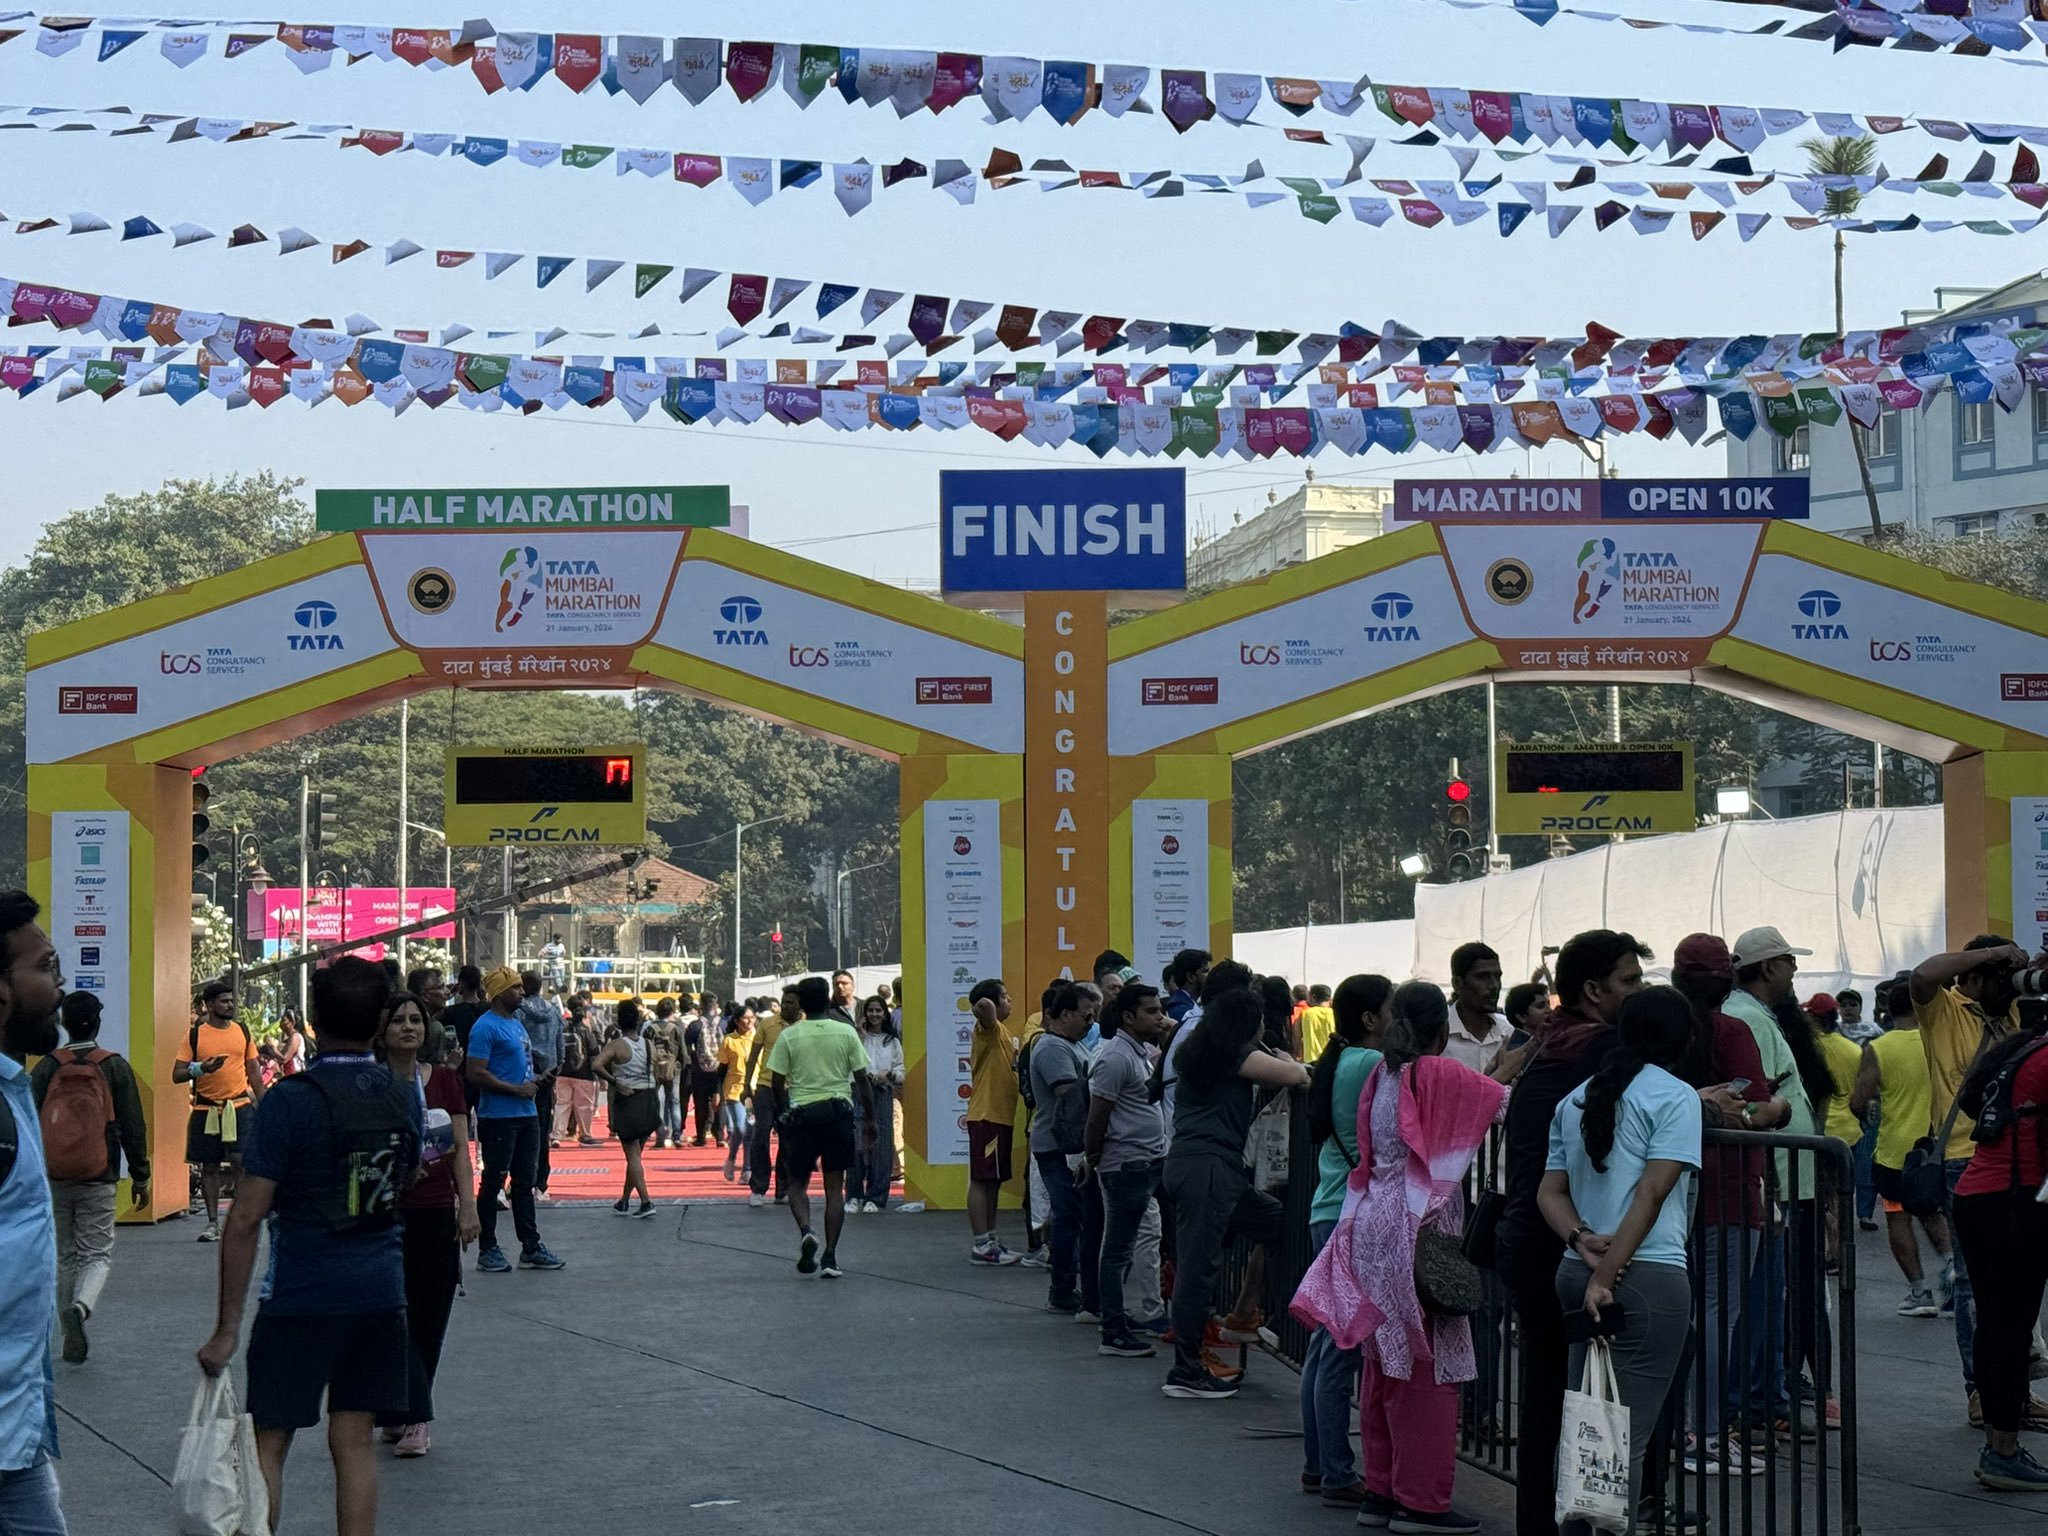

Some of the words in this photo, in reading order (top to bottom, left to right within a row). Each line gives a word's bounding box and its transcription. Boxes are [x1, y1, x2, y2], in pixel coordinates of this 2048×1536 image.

[1411, 487, 1583, 513] MARATHON
[1628, 487, 1708, 512] OPEN
[1719, 486, 1775, 511] 10K
[373, 495, 466, 525] HALF
[476, 492, 674, 524] MARATHON
[952, 503, 1166, 556] FINISH
[1623, 552, 1679, 567] TATA
[546, 560, 600, 575] TATA
[1623, 569, 1692, 585] MUMBAI
[545, 577, 614, 593] MUMBAI
[1623, 586, 1720, 602] MARATHON
[545, 594, 641, 611] MARATHON
[1635, 616, 1670, 626] January,
[1672, 616, 1691, 624] 2024
[546, 624, 555, 633] 21
[559, 624, 592, 634] January,
[594, 624, 613, 632] 2024
[1364, 626, 1421, 642] TATA
[1791, 625, 1849, 640] TATA
[287, 635, 344, 650] TATA
[713, 630, 769, 645] TATA
[1916, 636, 1942, 644] TATA
[835, 641, 859, 649] TATA
[1870, 637, 1912, 662] tcs
[1916, 645, 1976, 653] CONSULTANCY
[789, 643, 829, 667] tcs
[834, 650, 892, 658] CONSULTANCY
[1240, 641, 1280, 665] tcs
[1285, 649, 1344, 657] CONSULTANCY
[1520, 651, 1551, 664] टाटा
[1557, 645, 1589, 668] मुंबई
[1648, 651, 1689, 664] २०२४
[1916, 654, 1955, 662] SERVICES
[160, 650, 201, 674] tcs
[207, 656, 266, 665] CONSULTANCY
[442, 660, 473, 674] टाटा
[480, 654, 512, 678] मुंबई
[570, 658, 612, 673] २०२४
[834, 659, 871, 667] SERVICES
[1285, 658, 1323, 666] SERVICES
[207, 666, 245, 674] SERVICES
[942, 683, 962, 692] IDFC
[964, 683, 988, 691] FIRST
[1190, 684, 1214, 692] FIRST
[86, 693, 107, 701] IDFC
[108, 693, 133, 701] FIRST
[86, 702, 107, 711] Bank
[504, 747, 529, 755] HALF
[531, 747, 585, 755] MARATHON
[1541, 816, 1652, 830] PROCAM
[489, 828, 600, 841] PROCAM
[316, 920, 339, 928] WITH
